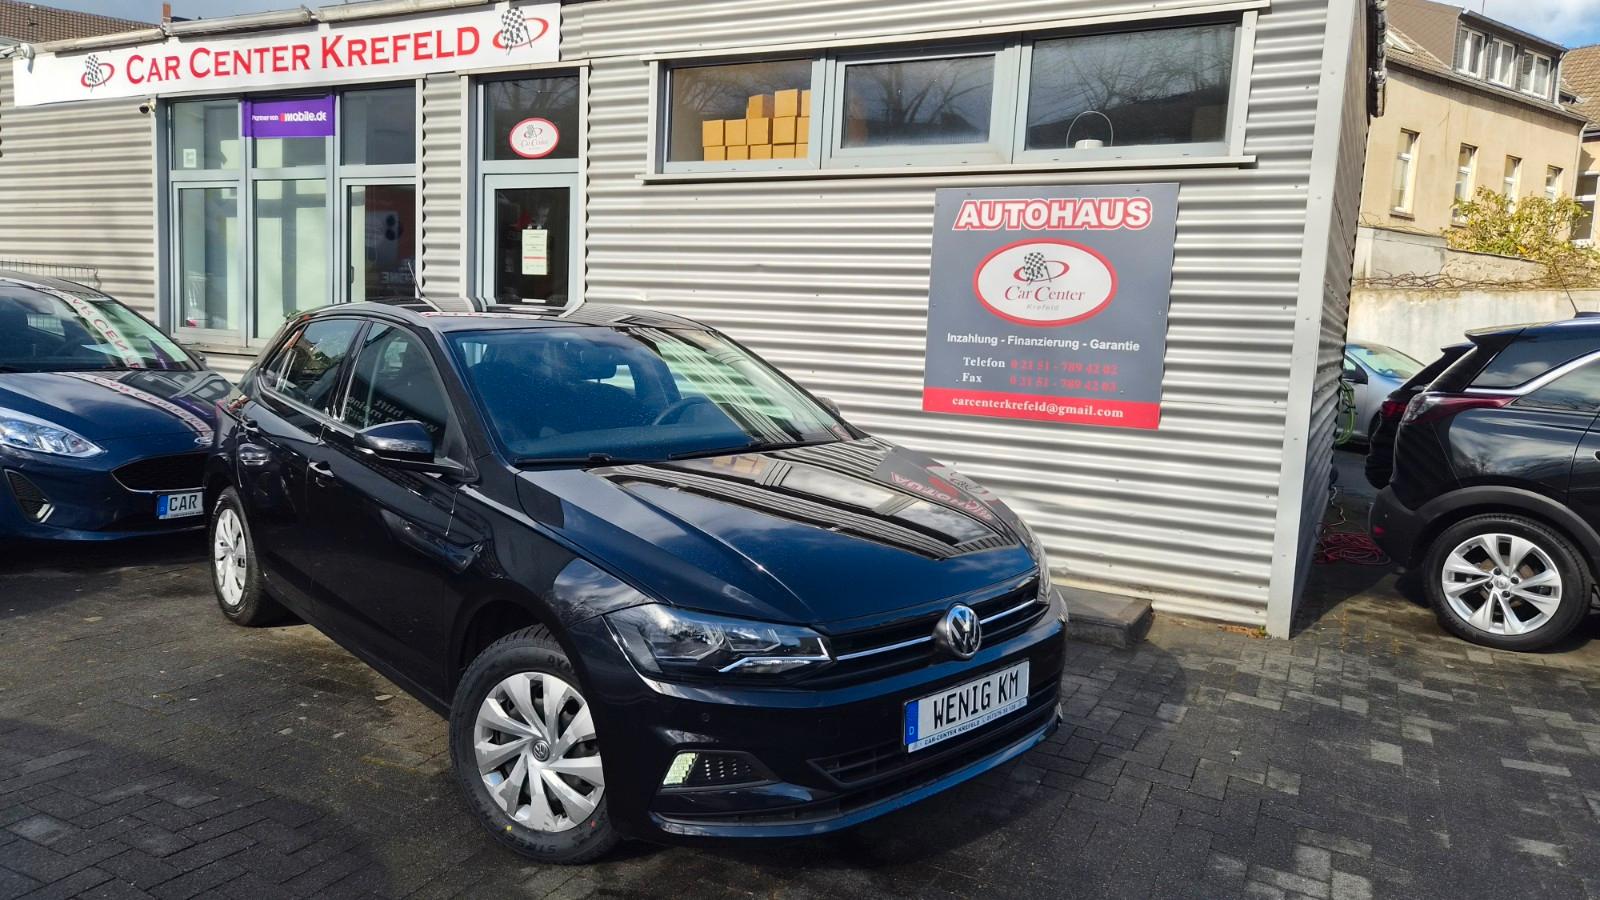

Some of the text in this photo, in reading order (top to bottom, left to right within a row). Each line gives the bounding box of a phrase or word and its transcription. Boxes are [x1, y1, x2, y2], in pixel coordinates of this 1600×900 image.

[126, 26, 480, 84] CAR CENTER KREFELD
[952, 196, 1153, 231] AUTOHAUS
[1004, 286, 1086, 302] Car Center
[947, 333, 998, 346] Inzahlung
[1007, 335, 1080, 350] Finanzierung
[1090, 339, 1140, 352] Garantie
[963, 357, 1006, 368] Telefon
[962, 372, 982, 383] Fax
[953, 397, 1124, 419] carcenterkrefeld@gmail.com
[170, 494, 198, 512] CAR
[933, 681, 991, 730] WENIG
[998, 670, 1019, 704] KM
